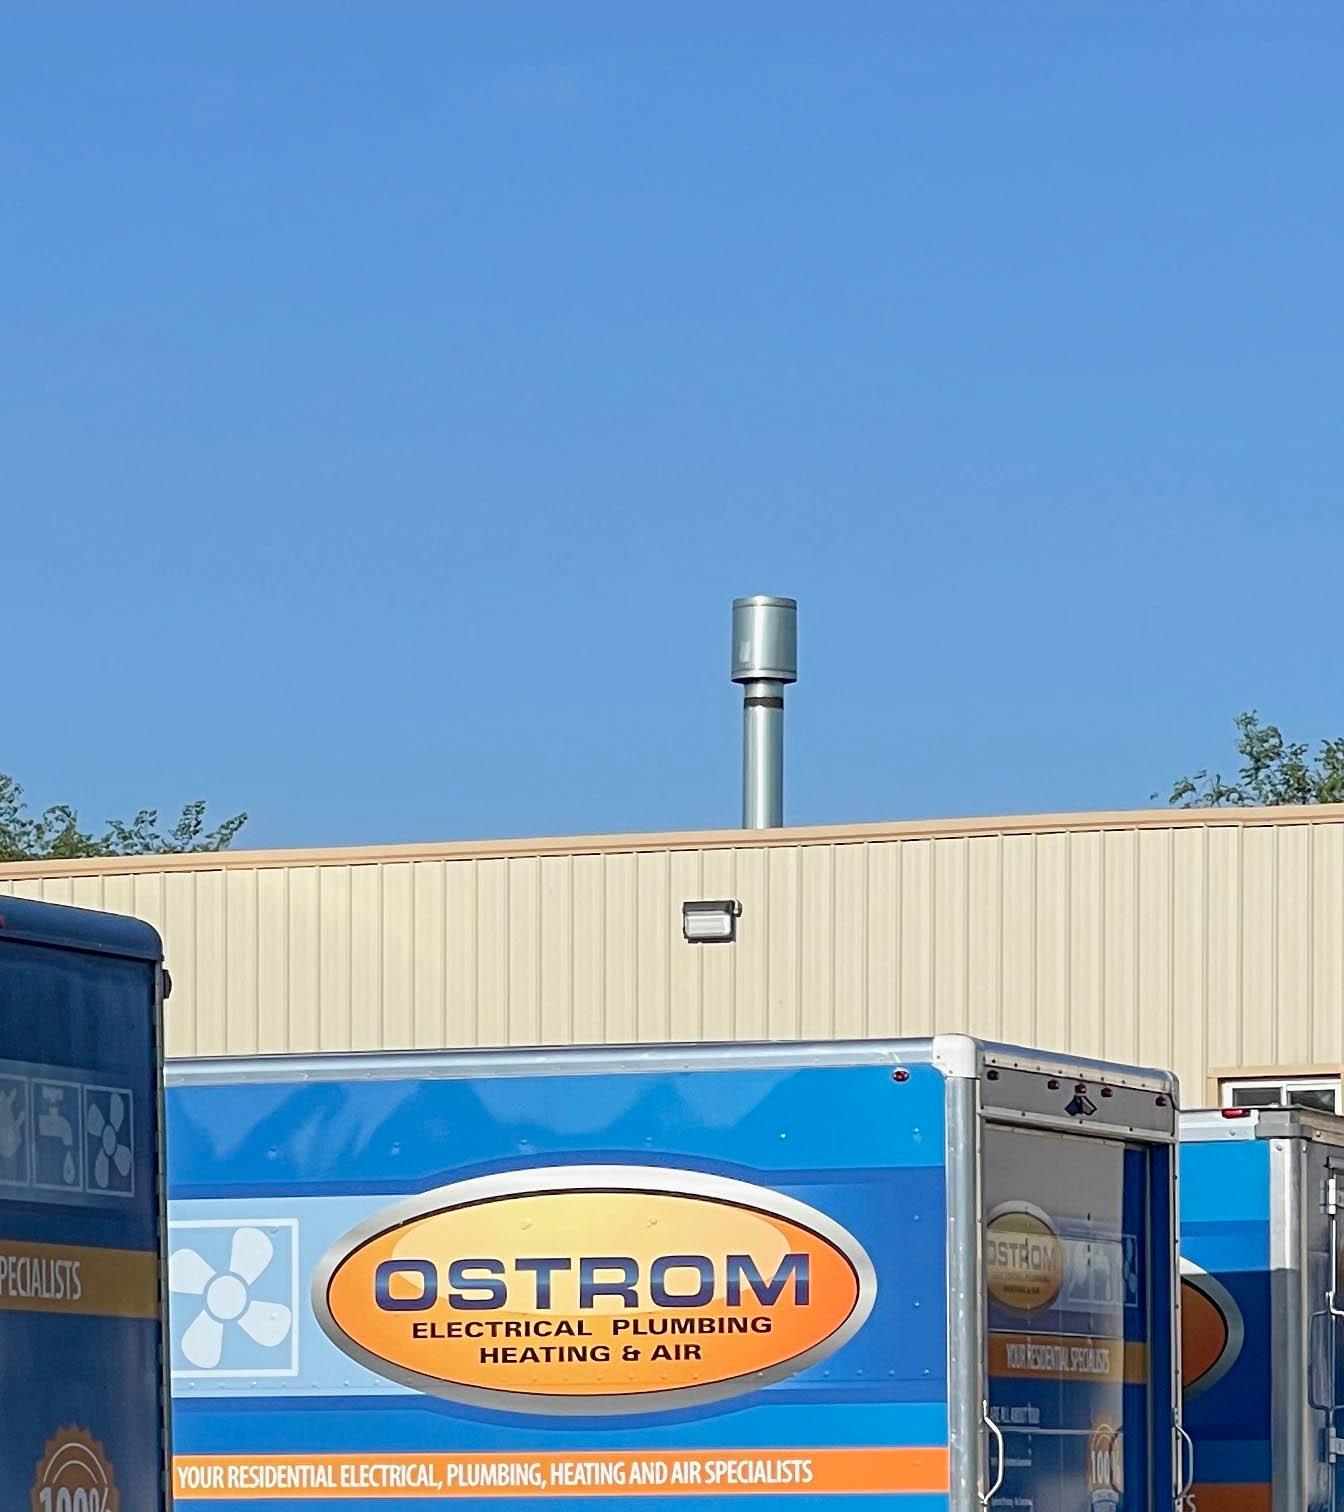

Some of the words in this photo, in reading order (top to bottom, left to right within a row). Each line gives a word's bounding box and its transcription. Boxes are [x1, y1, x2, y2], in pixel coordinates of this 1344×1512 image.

[374, 1254, 810, 1312] OSTROM
[412, 1319, 593, 1339] ELECTRICAL
[612, 1316, 773, 1336] PLUMBING
[479, 1345, 611, 1365] HEATING
[621, 1345, 641, 1362] &
[649, 1343, 703, 1362] AIR
[178, 1465, 224, 1489] YOUR
[228, 1464, 337, 1488] RESIDENTIAL
[341, 1463, 444, 1490] ELECTRICAL,
[447, 1462, 547, 1490] PLUMBING,
[551, 1461, 626, 1486] HEATING
[629, 1460, 668, 1485] AND
[671, 1460, 702, 1484] AIR
[705, 1459, 813, 1484] SPECIALISTS
